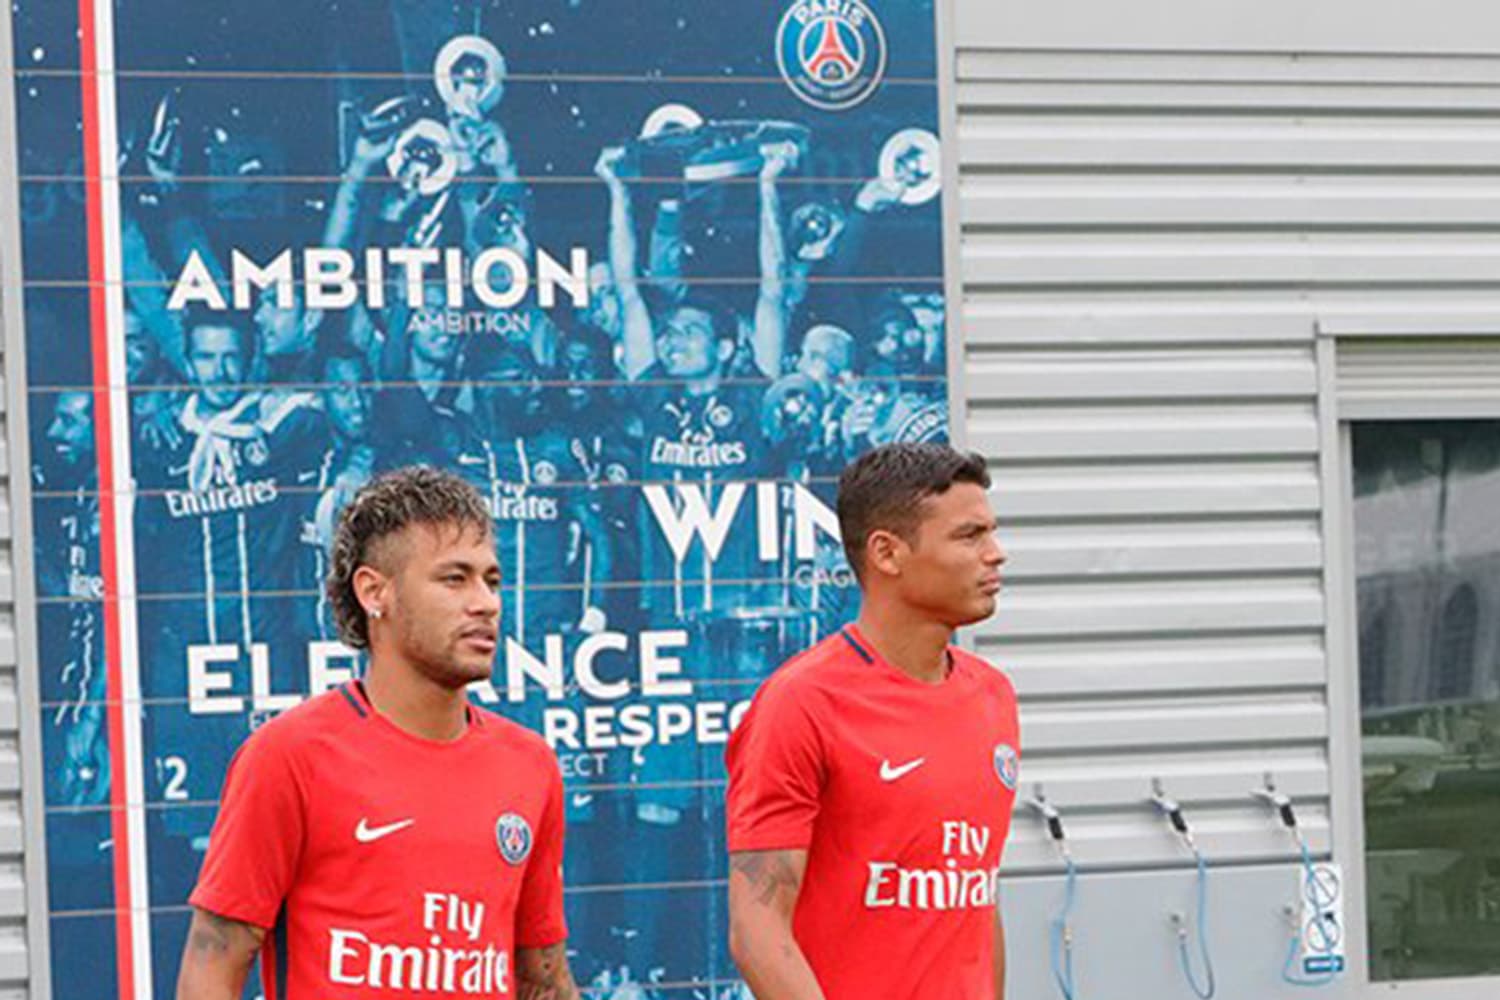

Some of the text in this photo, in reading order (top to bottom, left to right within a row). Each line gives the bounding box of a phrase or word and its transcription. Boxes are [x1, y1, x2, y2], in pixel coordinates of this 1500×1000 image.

[166, 247, 590, 311] AMBITION
[406, 310, 531, 335] AMBITION
[478, 494, 559, 521] irates
[793, 565, 857, 589] GAG
[186, 629, 693, 715] ELENCE
[544, 699, 753, 750] RESPE
[942, 820, 990, 861] Fly
[863, 861, 998, 910] Emira
[423, 892, 486, 940] Fly
[328, 927, 510, 994] Emirate
